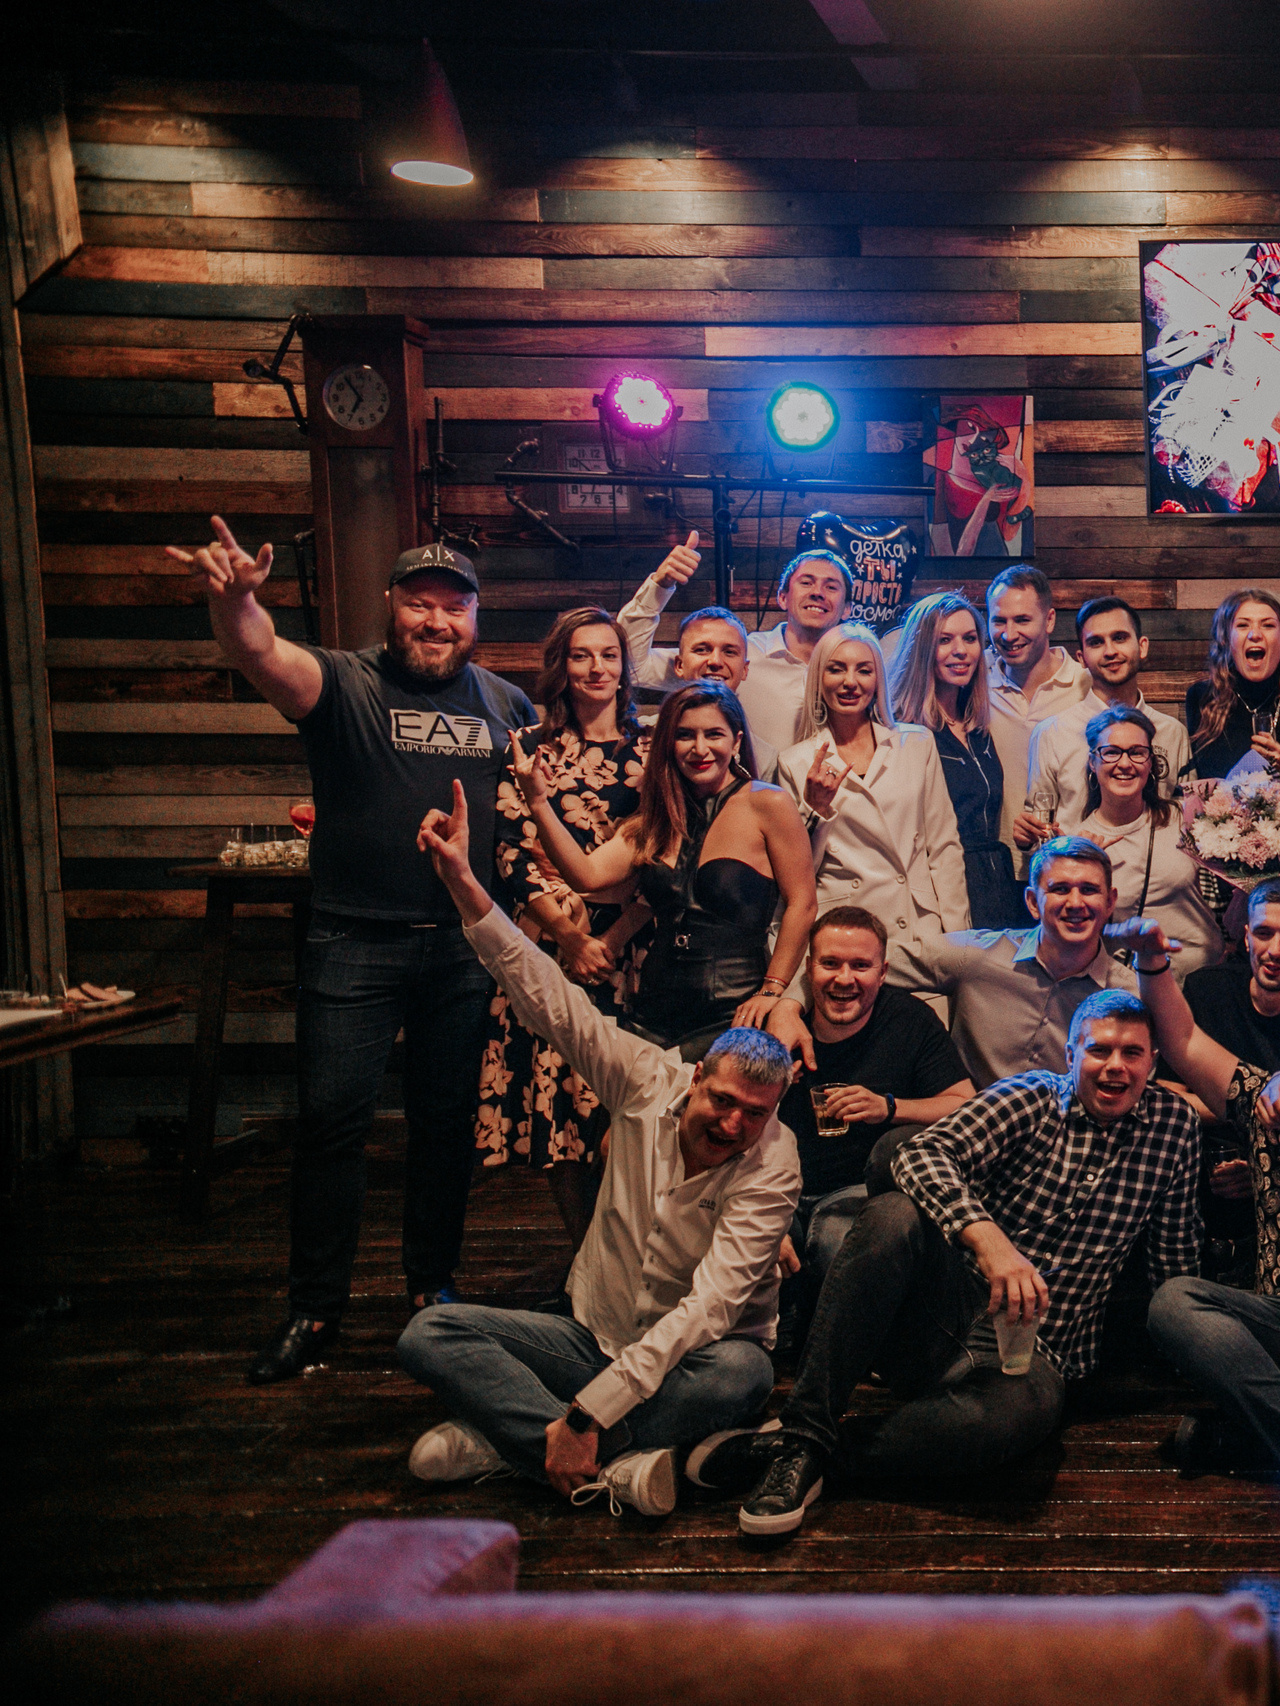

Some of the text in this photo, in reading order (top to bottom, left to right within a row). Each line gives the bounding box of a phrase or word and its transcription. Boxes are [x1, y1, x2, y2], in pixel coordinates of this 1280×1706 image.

[577, 449, 585, 458] 11
[590, 449, 600, 458] 12
[571, 485, 578, 494] 8
[580, 495, 586, 504] 7
[594, 495, 601, 505] 6
[863, 556, 897, 582] ТЫ
[394, 712, 483, 746] EA7
[394, 742, 491, 758] EMPORIO ARMANI
